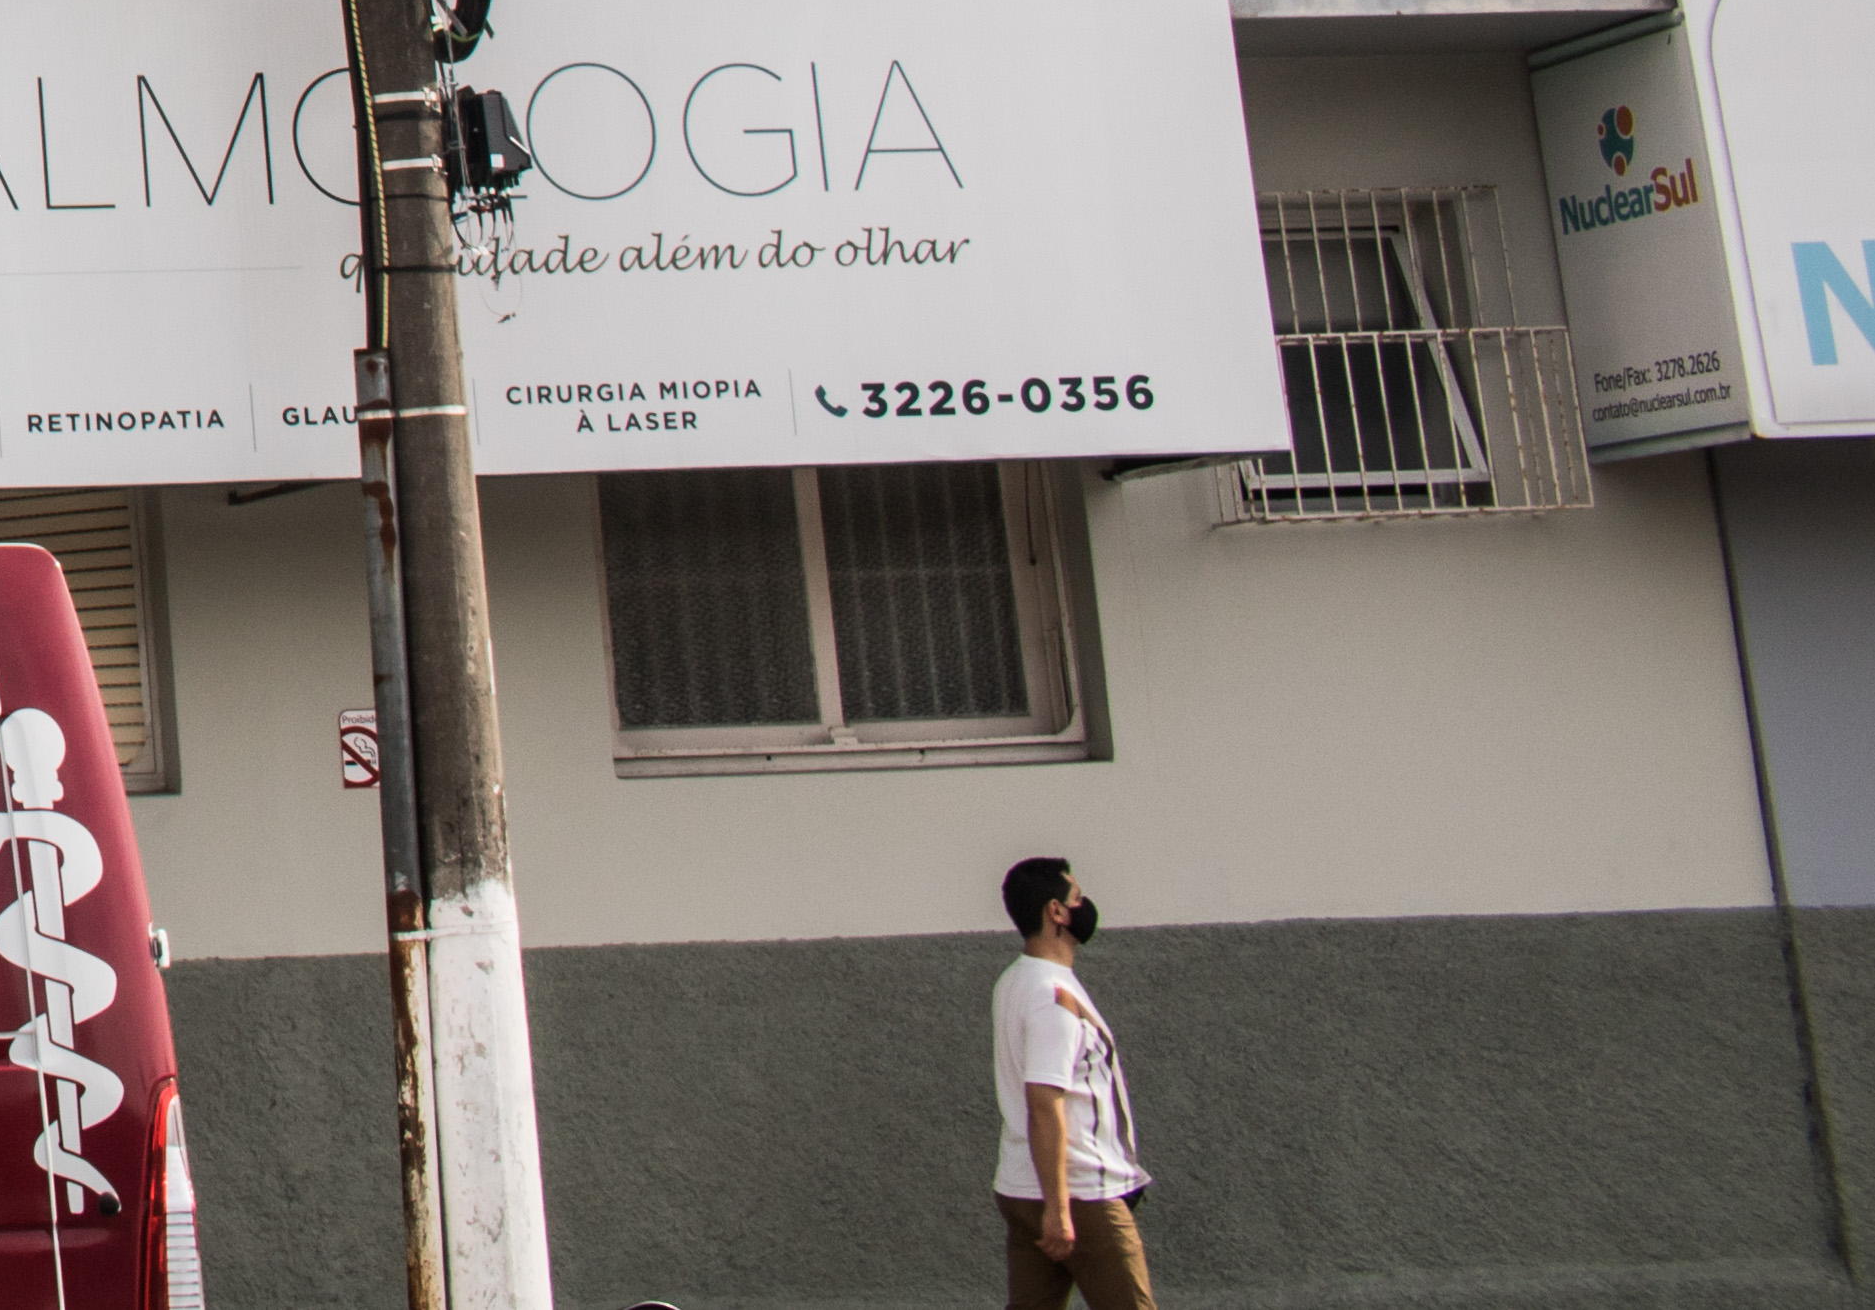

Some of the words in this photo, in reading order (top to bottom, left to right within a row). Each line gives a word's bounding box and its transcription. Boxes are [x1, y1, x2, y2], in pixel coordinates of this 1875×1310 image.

[1559, 157, 1698, 235] NuclearSul
[340, 235, 610, 293] qidade
[619, 232, 748, 273] além
[758, 229, 826, 269] do
[834, 227, 971, 267] olhar
[1594, 366, 1652, 393] Fone/Fax:
[1654, 350, 1720, 382] 3278.2626
[505, 382, 646, 406] CIRURGIA
[658, 379, 762, 400] MIOPIA
[860, 374, 1155, 419] 3226-0356
[1592, 383, 1731, 422] contato@nuclearsul.com.br
[27, 409, 226, 434] RETINOPATIA
[282, 406, 357, 427] GLAU
[576, 409, 596, 433] À
[607, 410, 698, 432] LASER
[342, 714, 376, 724] Proibid
